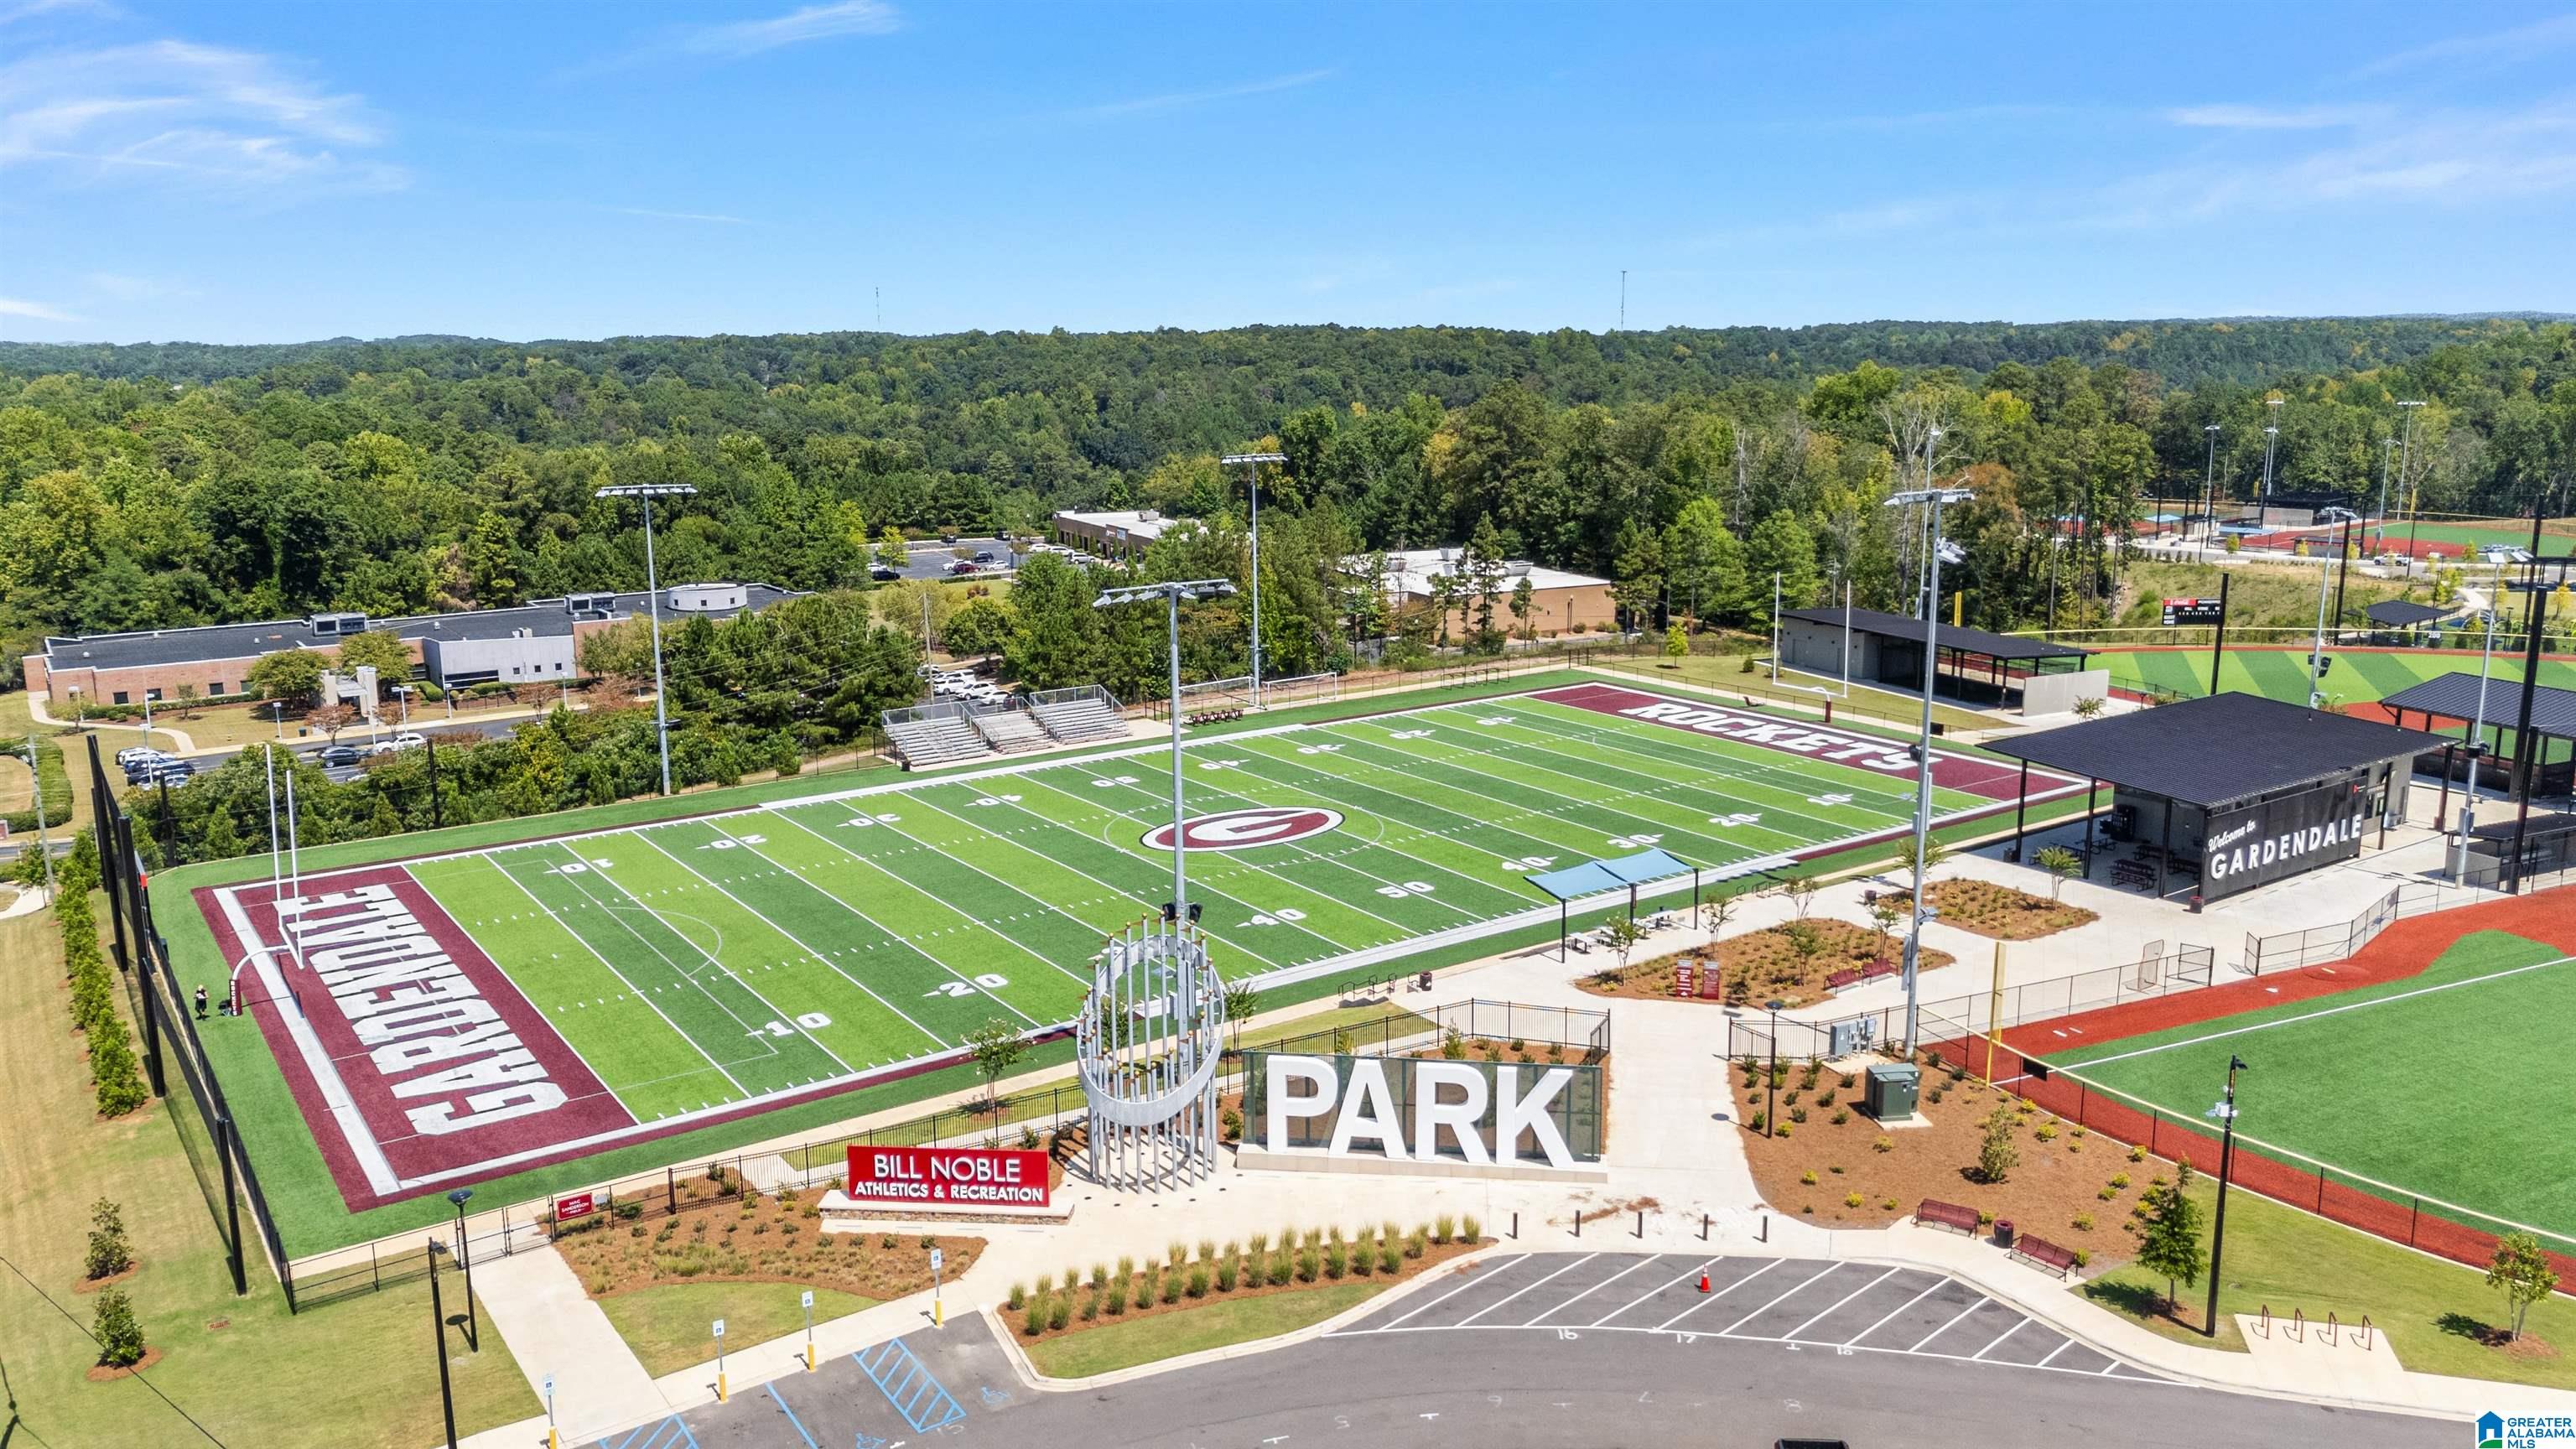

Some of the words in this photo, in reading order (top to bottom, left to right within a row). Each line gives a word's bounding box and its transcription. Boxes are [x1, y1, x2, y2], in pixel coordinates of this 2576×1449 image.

[1618, 703, 1942, 770] ROCKETS
[1607, 834, 1659, 849] 30
[2208, 824, 2246, 853] Welcome
[2246, 819, 2256, 833] to
[2211, 813, 2361, 880] GARDENDALE
[1375, 881, 1435, 898] 50
[1251, 908, 1307, 926] 40
[939, 974, 1008, 997] 20
[272, 884, 569, 1135] GARDENDALE
[765, 1012, 832, 1036] 10
[1266, 1055, 1575, 1168] PARK
[874, 1154, 922, 1179] BILL
[931, 1156, 1021, 1182] NOBLE
[854, 1182, 928, 1197] ATHLETICS
[933, 1185, 944, 1198] &
[951, 1185, 1043, 1202] RECREATION
[1557, 1327, 1578, 1340] 16
[1677, 1333, 1696, 1343] 17
